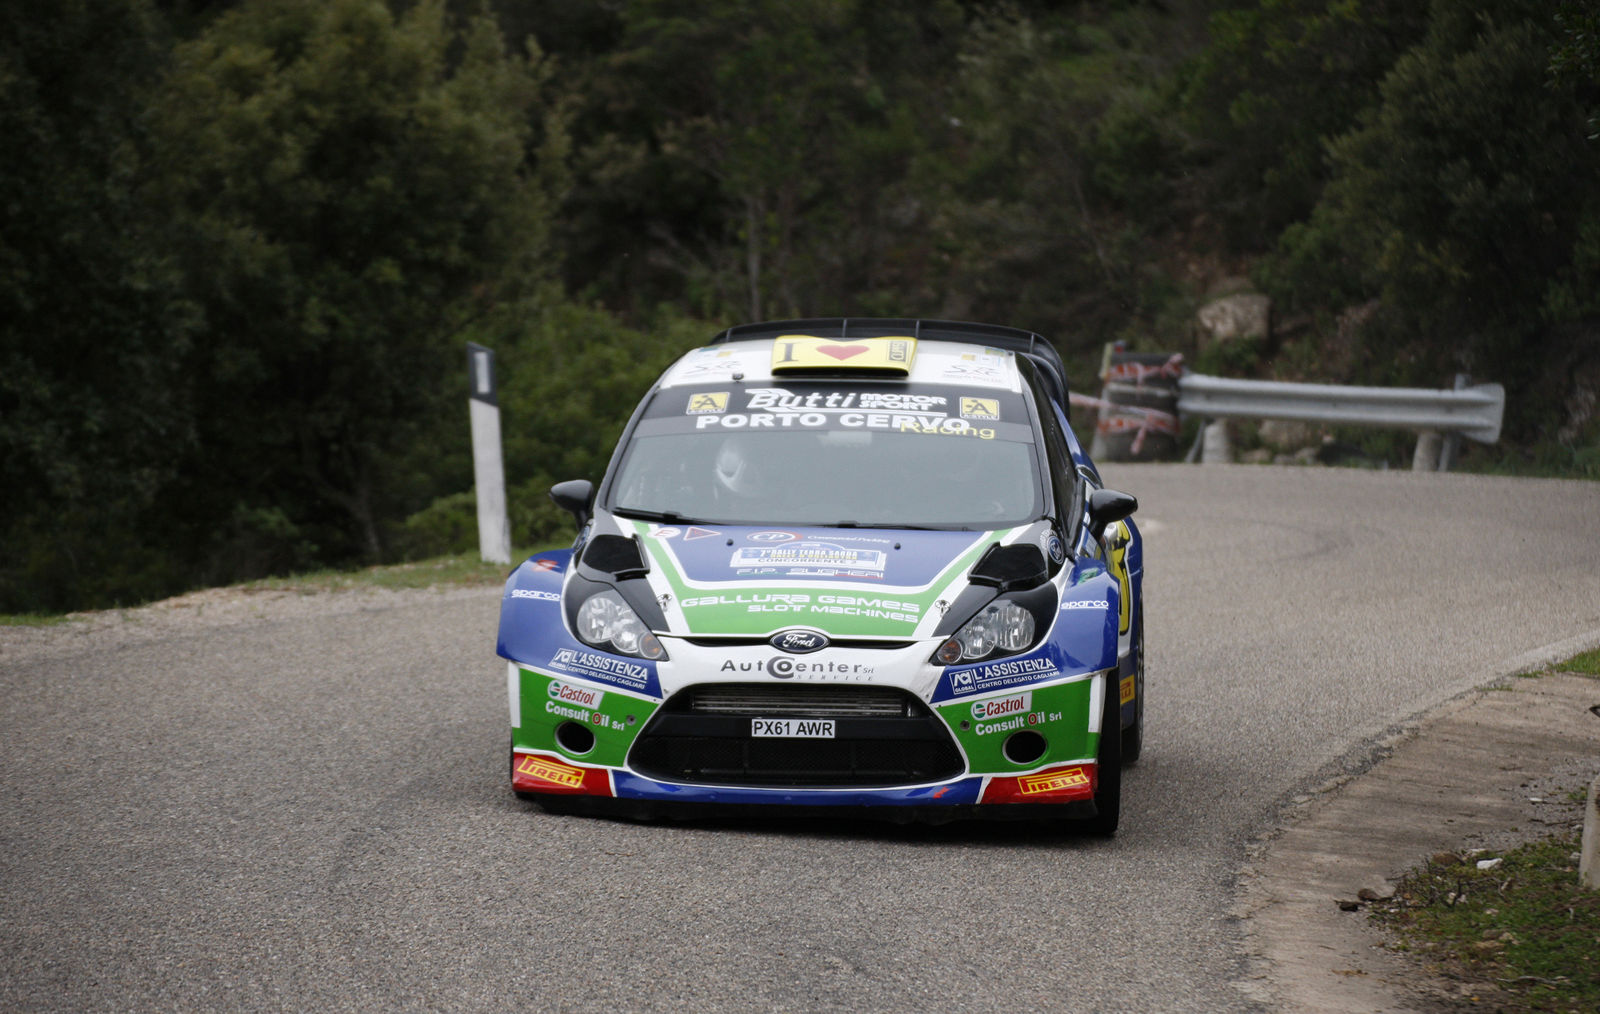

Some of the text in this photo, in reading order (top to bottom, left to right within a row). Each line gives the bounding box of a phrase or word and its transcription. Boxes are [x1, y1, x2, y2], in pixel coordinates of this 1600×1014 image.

[775, 341, 799, 363] I
[745, 388, 857, 409] Butti
[859, 392, 948, 405] MOTOR
[859, 399, 935, 411] SPORT
[695, 412, 970, 433] PORTO CERVO
[900, 421, 996, 440] Racing
[511, 589, 562, 600] sparco
[1061, 600, 1110, 609] sparco
[748, 604, 807, 612] SLOT
[782, 634, 816, 647] Ford
[571, 650, 648, 680] L'ASSISTENZA
[974, 657, 1055, 681] L'ASSISTENZA
[566, 666, 646, 690] CENTRO DELEGATO CAGLIARI
[976, 671, 1060, 690] CENTRO DELEGATO CAGLIARI
[559, 685, 596, 705] Castrol
[954, 684, 975, 693] GLOBAL
[545, 700, 625, 731] Consult Oil Srl
[986, 696, 1025, 717] Castrol
[753, 721, 833, 736] PX61 AWR
[975, 711, 1063, 736] Consult Oil Srl
[520, 757, 584, 787] PIRELLI
[1018, 768, 1088, 794] PIRELLI
